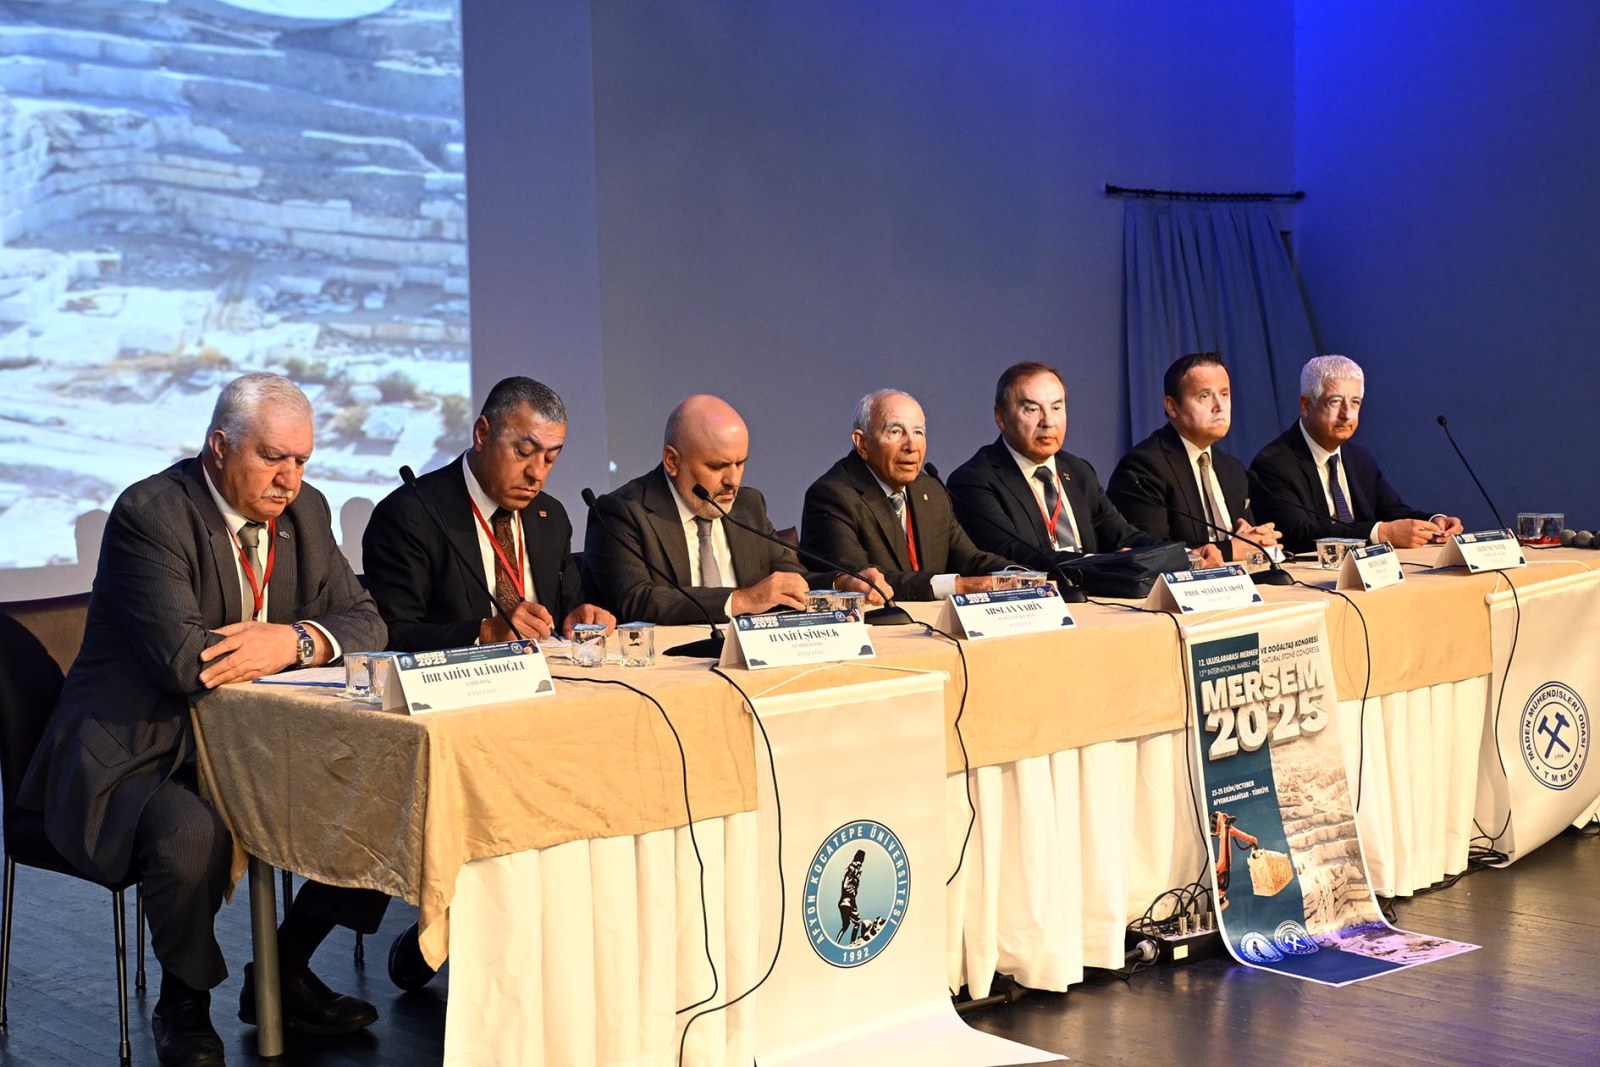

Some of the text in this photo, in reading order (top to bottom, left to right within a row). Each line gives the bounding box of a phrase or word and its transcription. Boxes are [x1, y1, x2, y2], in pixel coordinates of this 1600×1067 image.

[753, 620, 780, 628] 2025
[769, 628, 840, 642] HANİFİ ŞİMŞEK
[418, 657, 447, 667] 2025
[1206, 652, 1239, 665] ULUSLARARASI
[1240, 648, 1258, 658] MERMER
[1268, 642, 1294, 653] DOĞALTAŞ
[1208, 664, 1236, 676] INTERNATIONAL
[1262, 655, 1280, 664] NATURAL
[1282, 652, 1295, 661] STONE
[1296, 646, 1320, 657] CONGRESS
[421, 667, 471, 684] İBRAHİM
[472, 660, 527, 678] ALİMOĞLU
[1201, 659, 1324, 715] MERSEM
[1205, 690, 1328, 761] 2025
[1525, 720, 1535, 760] MADEN
[1578, 713, 1586, 748] ODASI
[1544, 762, 1578, 782] TMMOB
[810, 826, 863, 885] KOCATEPE
[807, 895, 825, 944] AFYON
[843, 947, 869, 962] 1992
